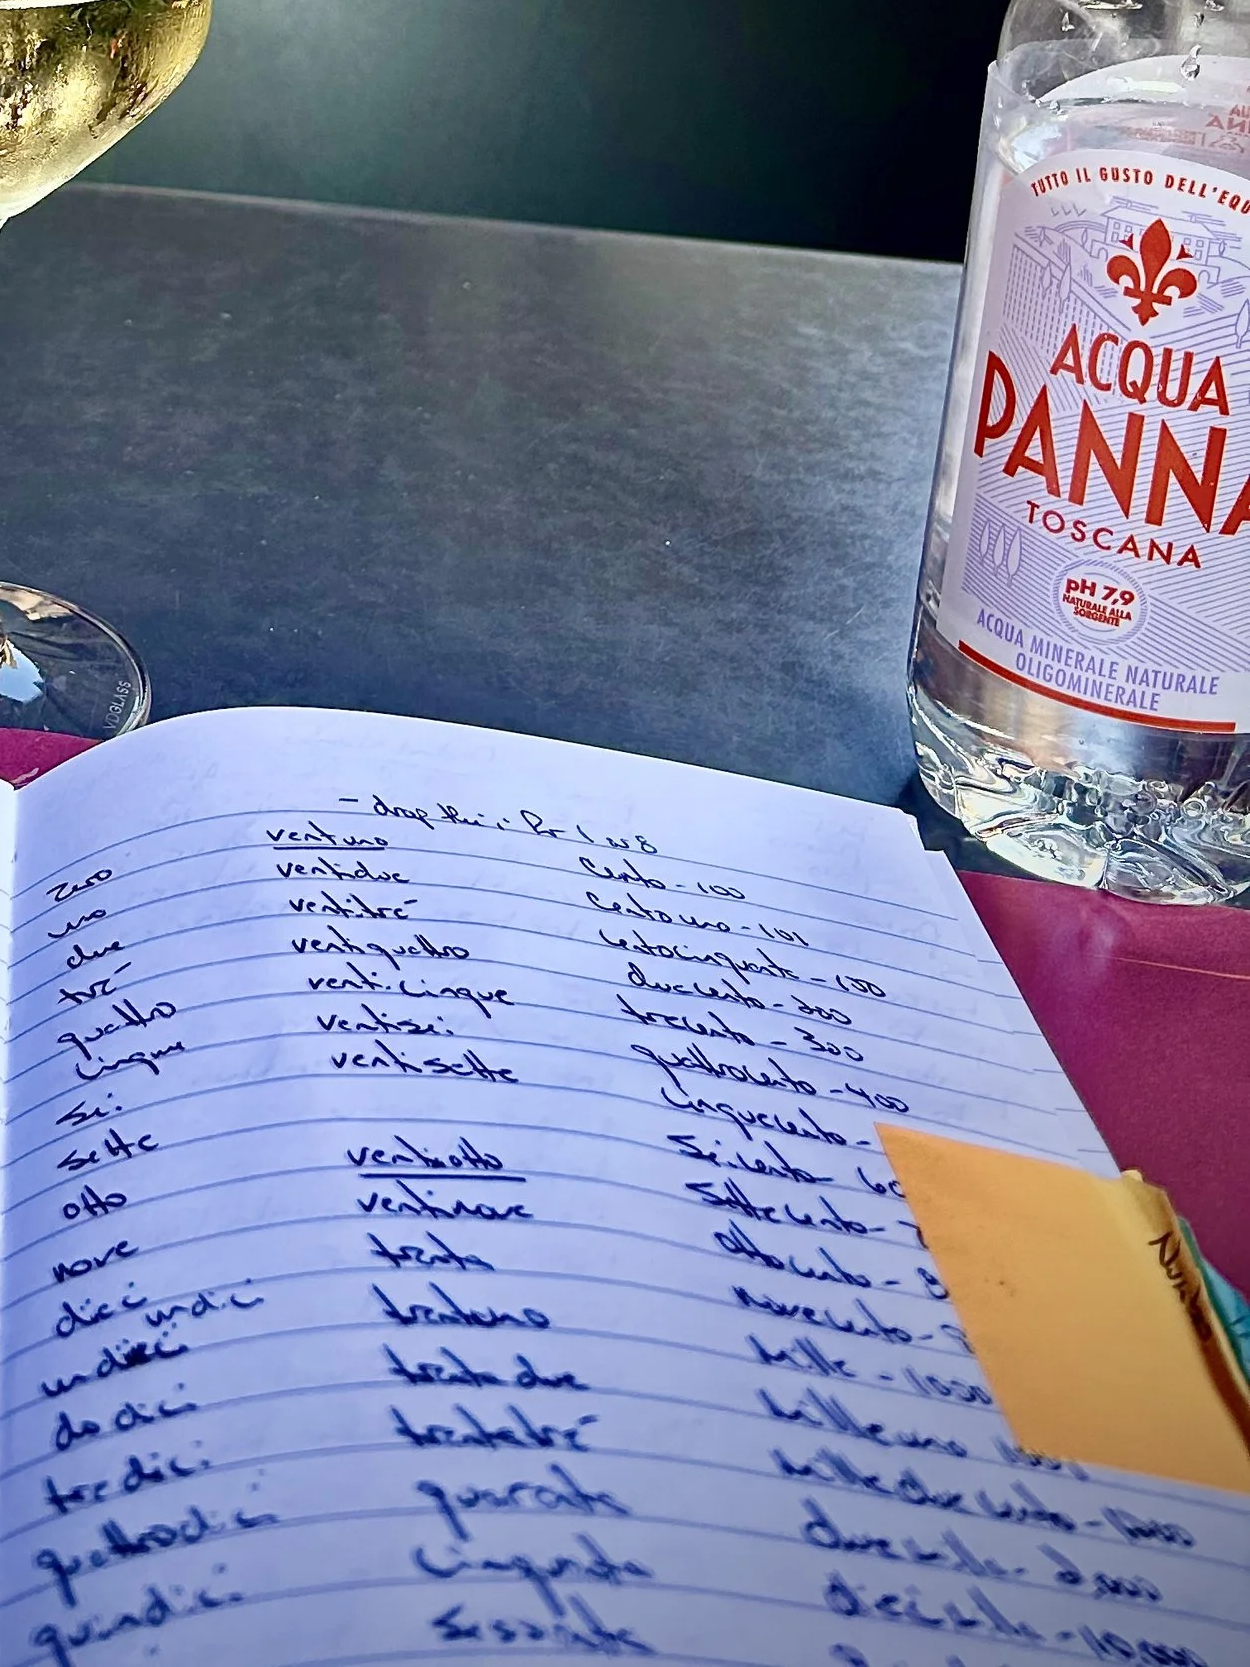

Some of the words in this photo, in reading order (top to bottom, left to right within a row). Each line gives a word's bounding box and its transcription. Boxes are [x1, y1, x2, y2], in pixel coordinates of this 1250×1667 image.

[1031, 171, 1069, 197] TUTTO
[1076, 167, 1091, 183] IL
[1099, 167, 1152, 185] GUSTO
[1050, 323, 1230, 416] ACQUA
[1026, 500, 1201, 569] TOSCANA
[1062, 594, 1108, 614] NATURALE
[1109, 607, 1132, 621] ALLA
[1065, 578, 1097, 597] pH
[1101, 584, 1135, 606] 7,9
[1073, 606, 1120, 627] SORGENTE
[977, 609, 1025, 648] ACQUA
[1030, 633, 1119, 681] MINERALE
[1125, 664, 1220, 695] NATURALE
[1015, 652, 1161, 712] OLIGOMINERALE
